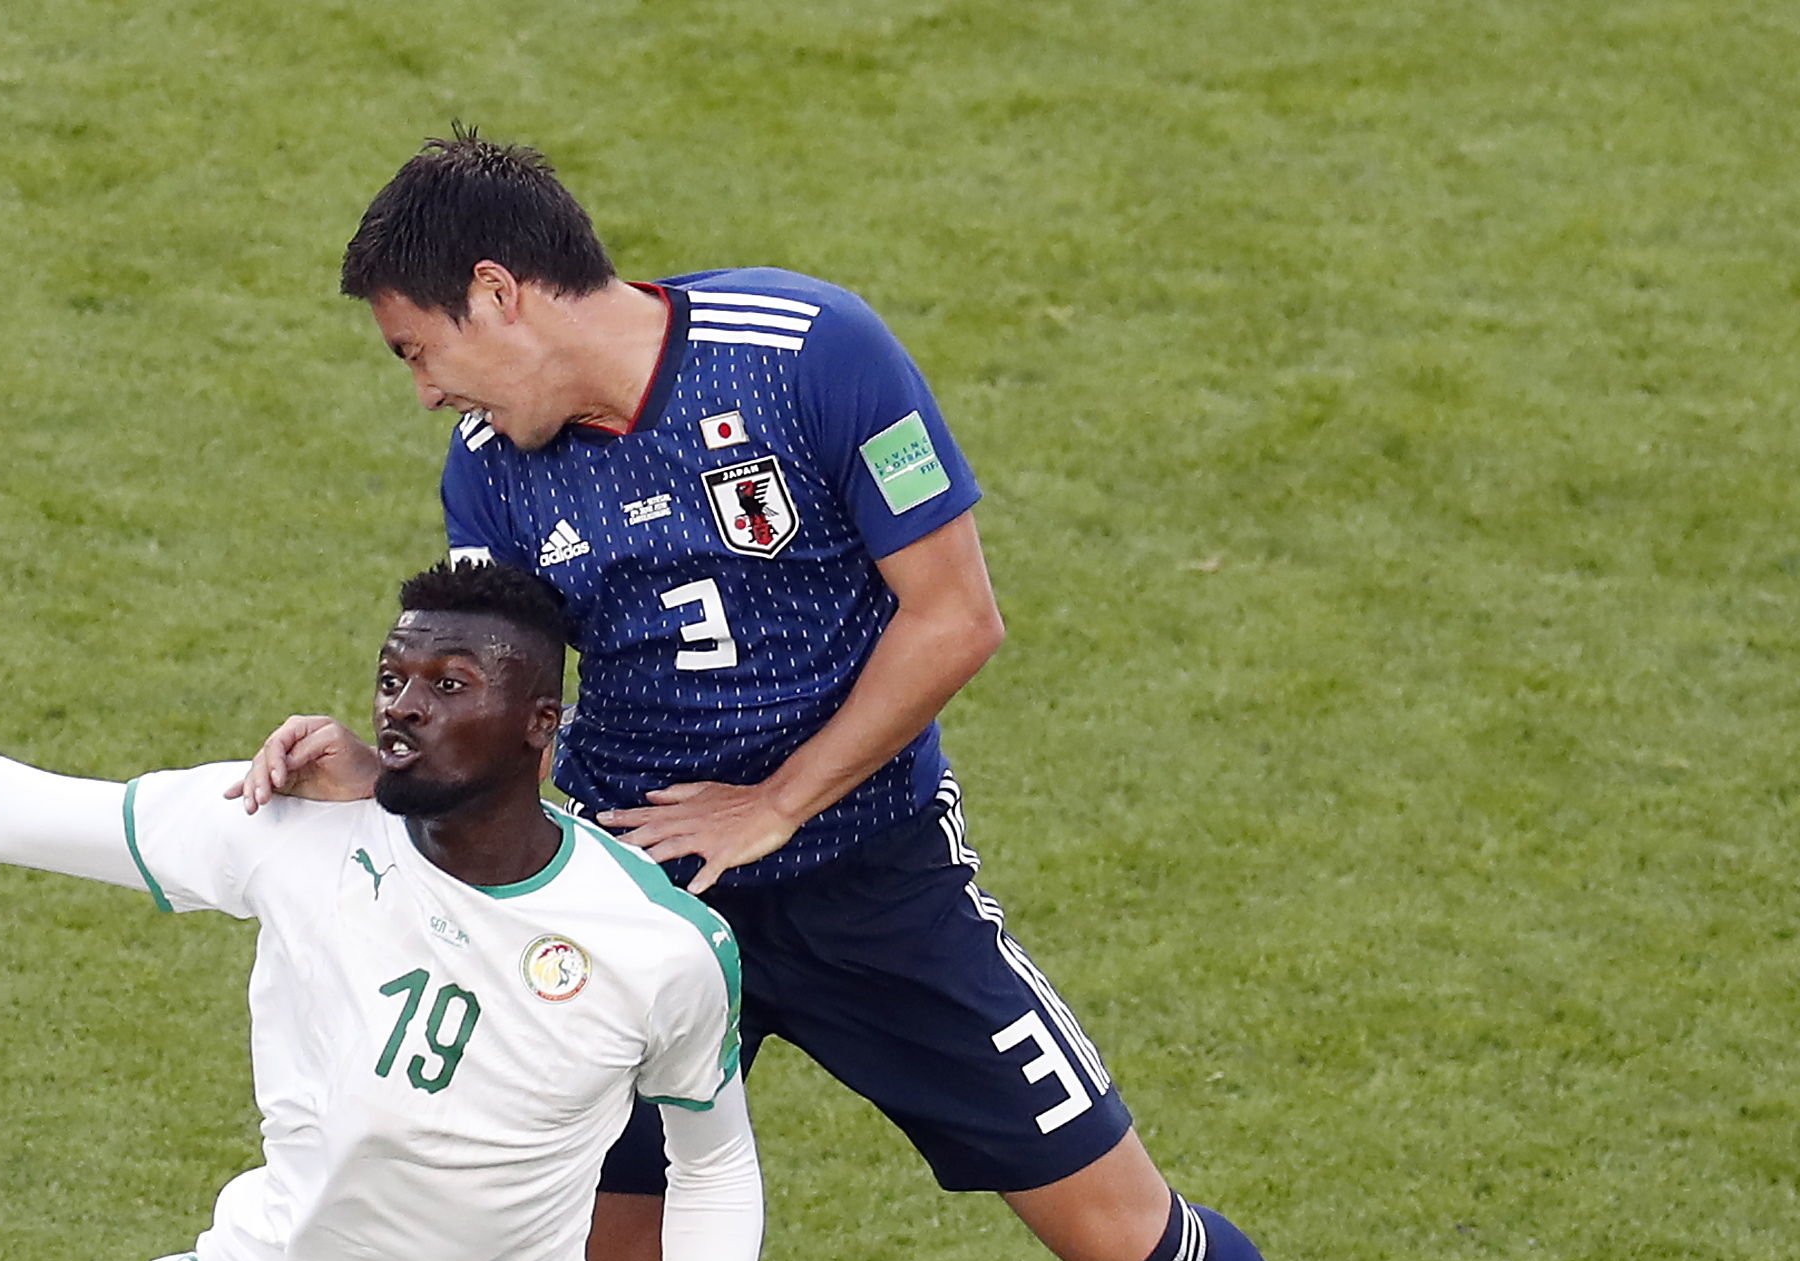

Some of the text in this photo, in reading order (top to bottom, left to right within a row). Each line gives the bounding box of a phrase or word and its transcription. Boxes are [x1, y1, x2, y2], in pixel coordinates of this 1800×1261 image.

[722, 464, 760, 481] JAPAN
[540, 541, 590, 567] adidas
[660, 578, 738, 671] 3
[375, 967, 482, 1095] 19
[991, 1009, 1093, 1135] 3
